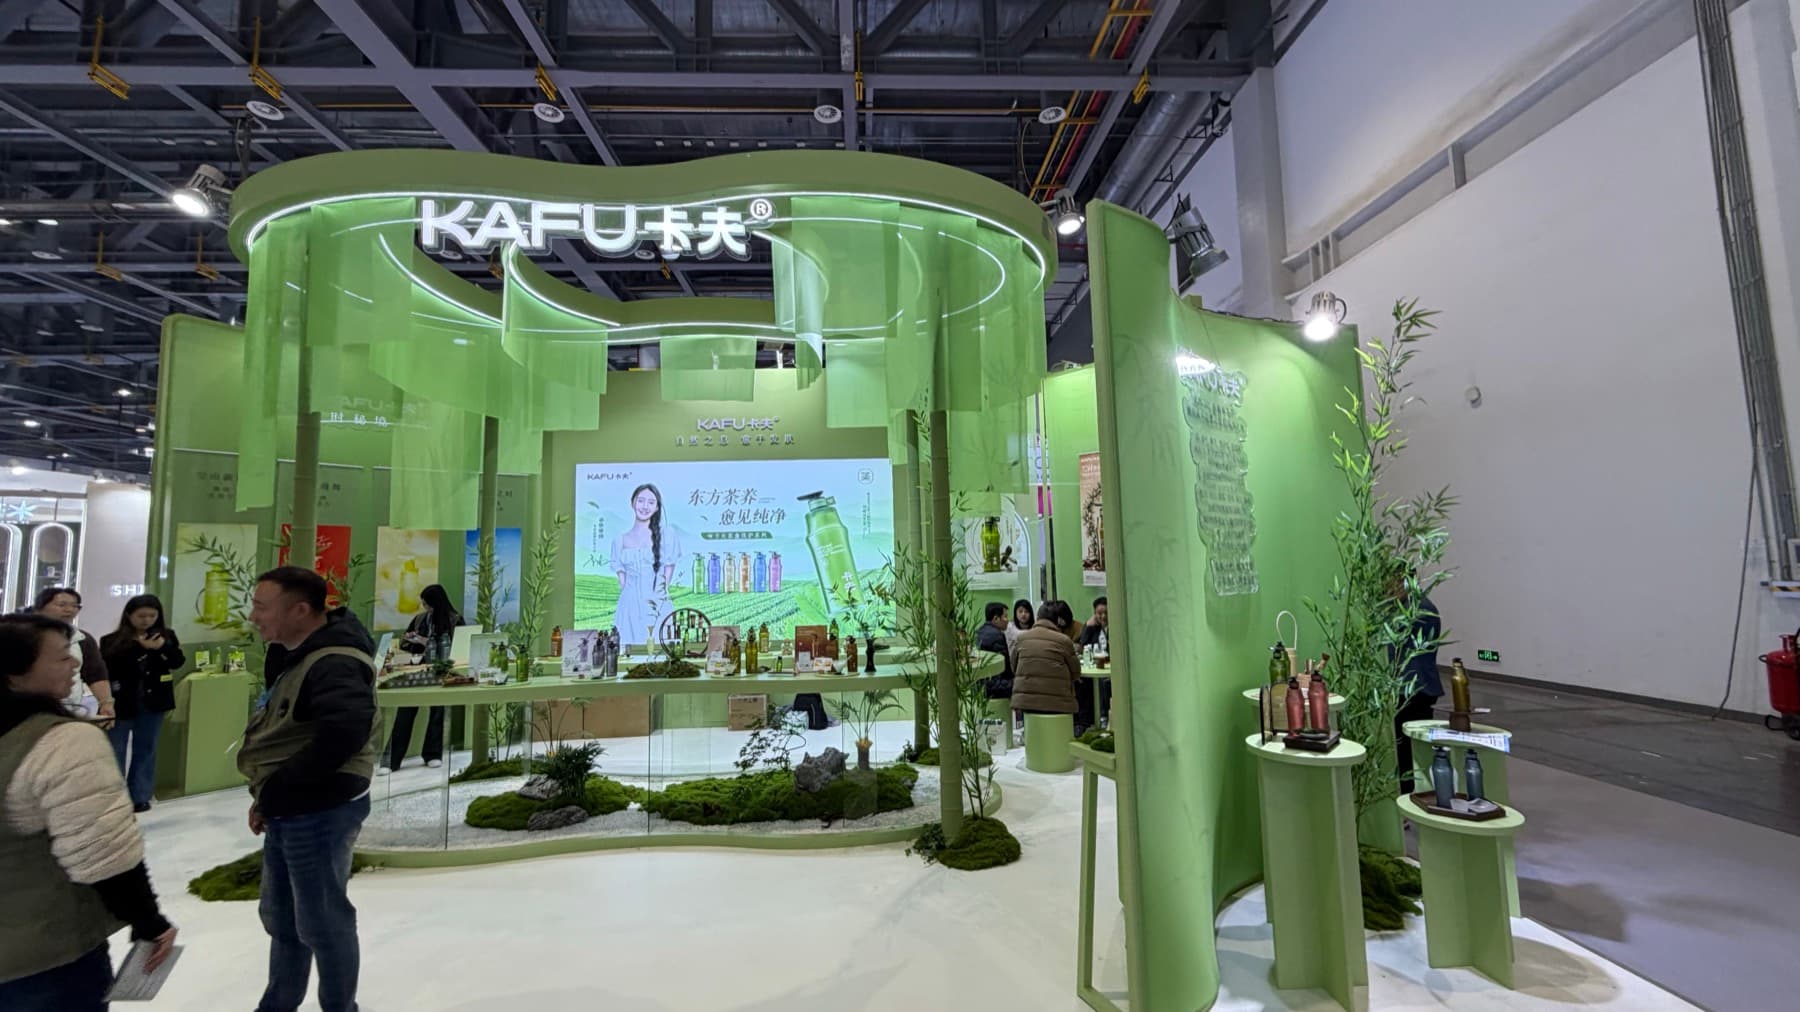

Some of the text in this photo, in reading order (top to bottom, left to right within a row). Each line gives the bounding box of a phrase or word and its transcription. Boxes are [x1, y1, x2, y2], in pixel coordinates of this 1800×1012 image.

[420, 199, 638, 252] KAFU
[697, 418, 746, 431] KAFU
[587, 472, 614, 481] KAFU
[688, 488, 758, 506] 东方茶养
[719, 508, 786, 526] 愈见纯净
